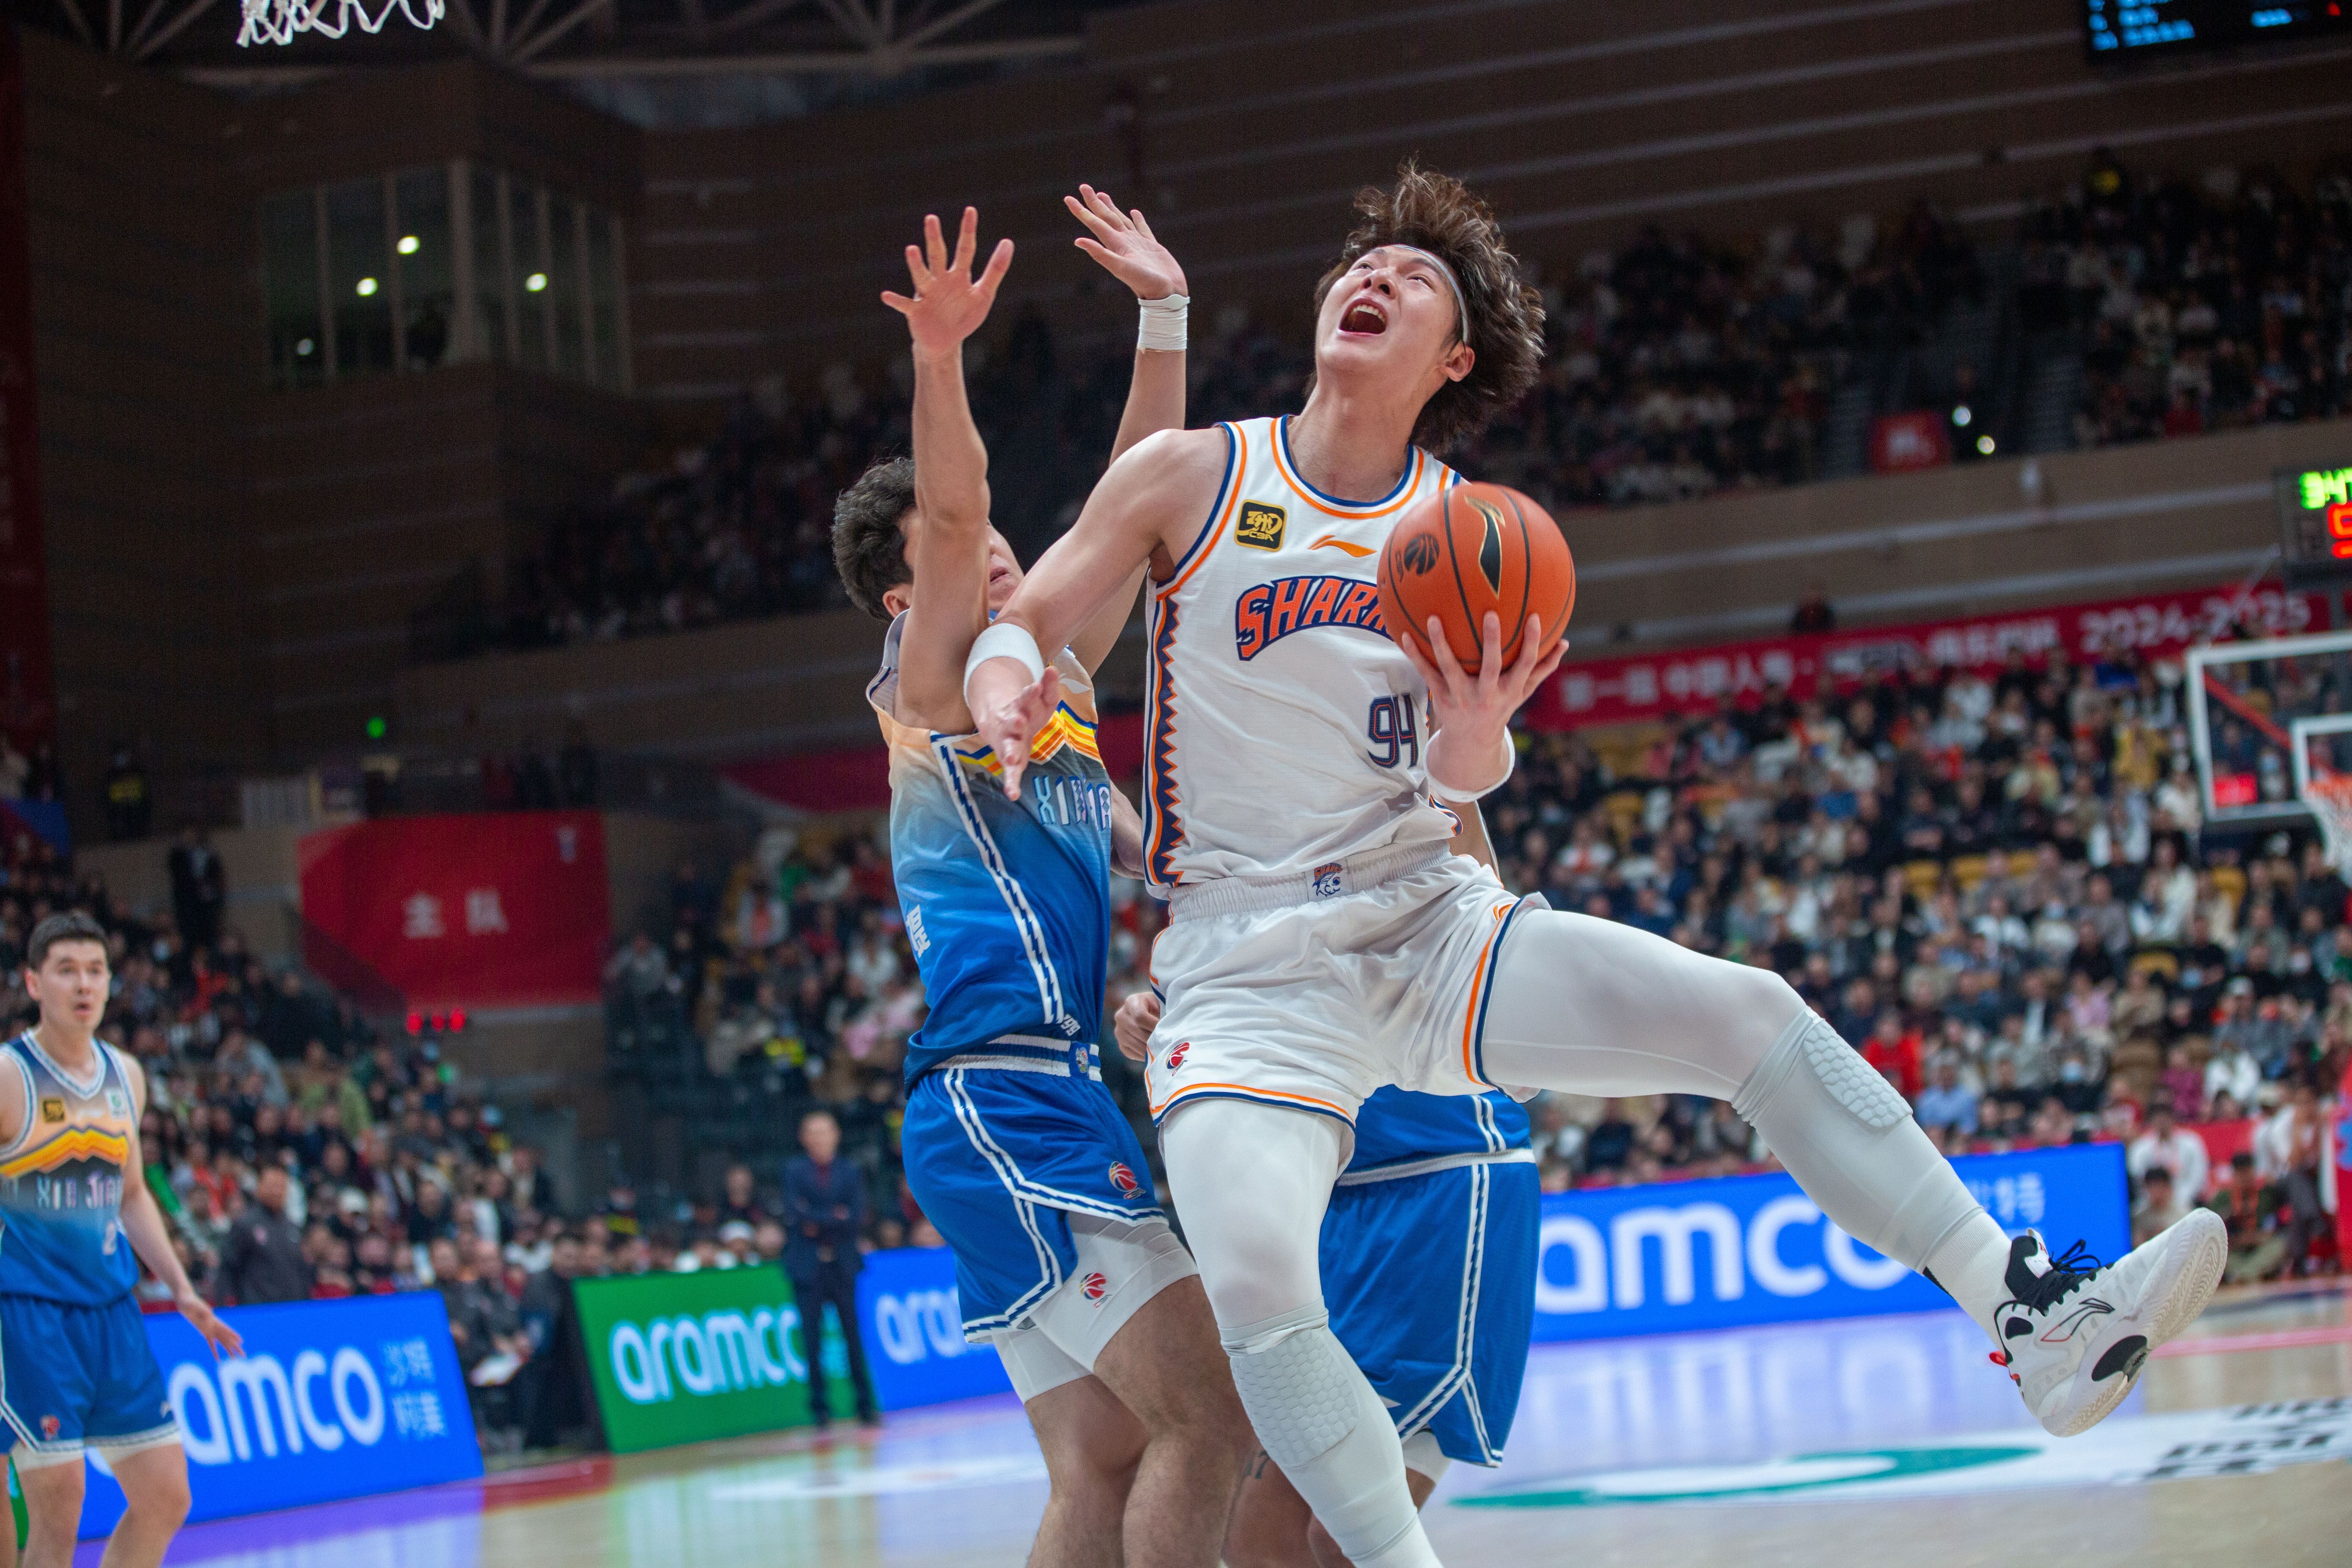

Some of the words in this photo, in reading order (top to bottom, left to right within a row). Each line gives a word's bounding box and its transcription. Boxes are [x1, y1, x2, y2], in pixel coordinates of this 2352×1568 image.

[1235, 575, 1396, 661] SHAR
[1368, 693, 1419, 769] 94
[1535, 1194, 1918, 1316] amco
[168, 1347, 385, 1465] amco
